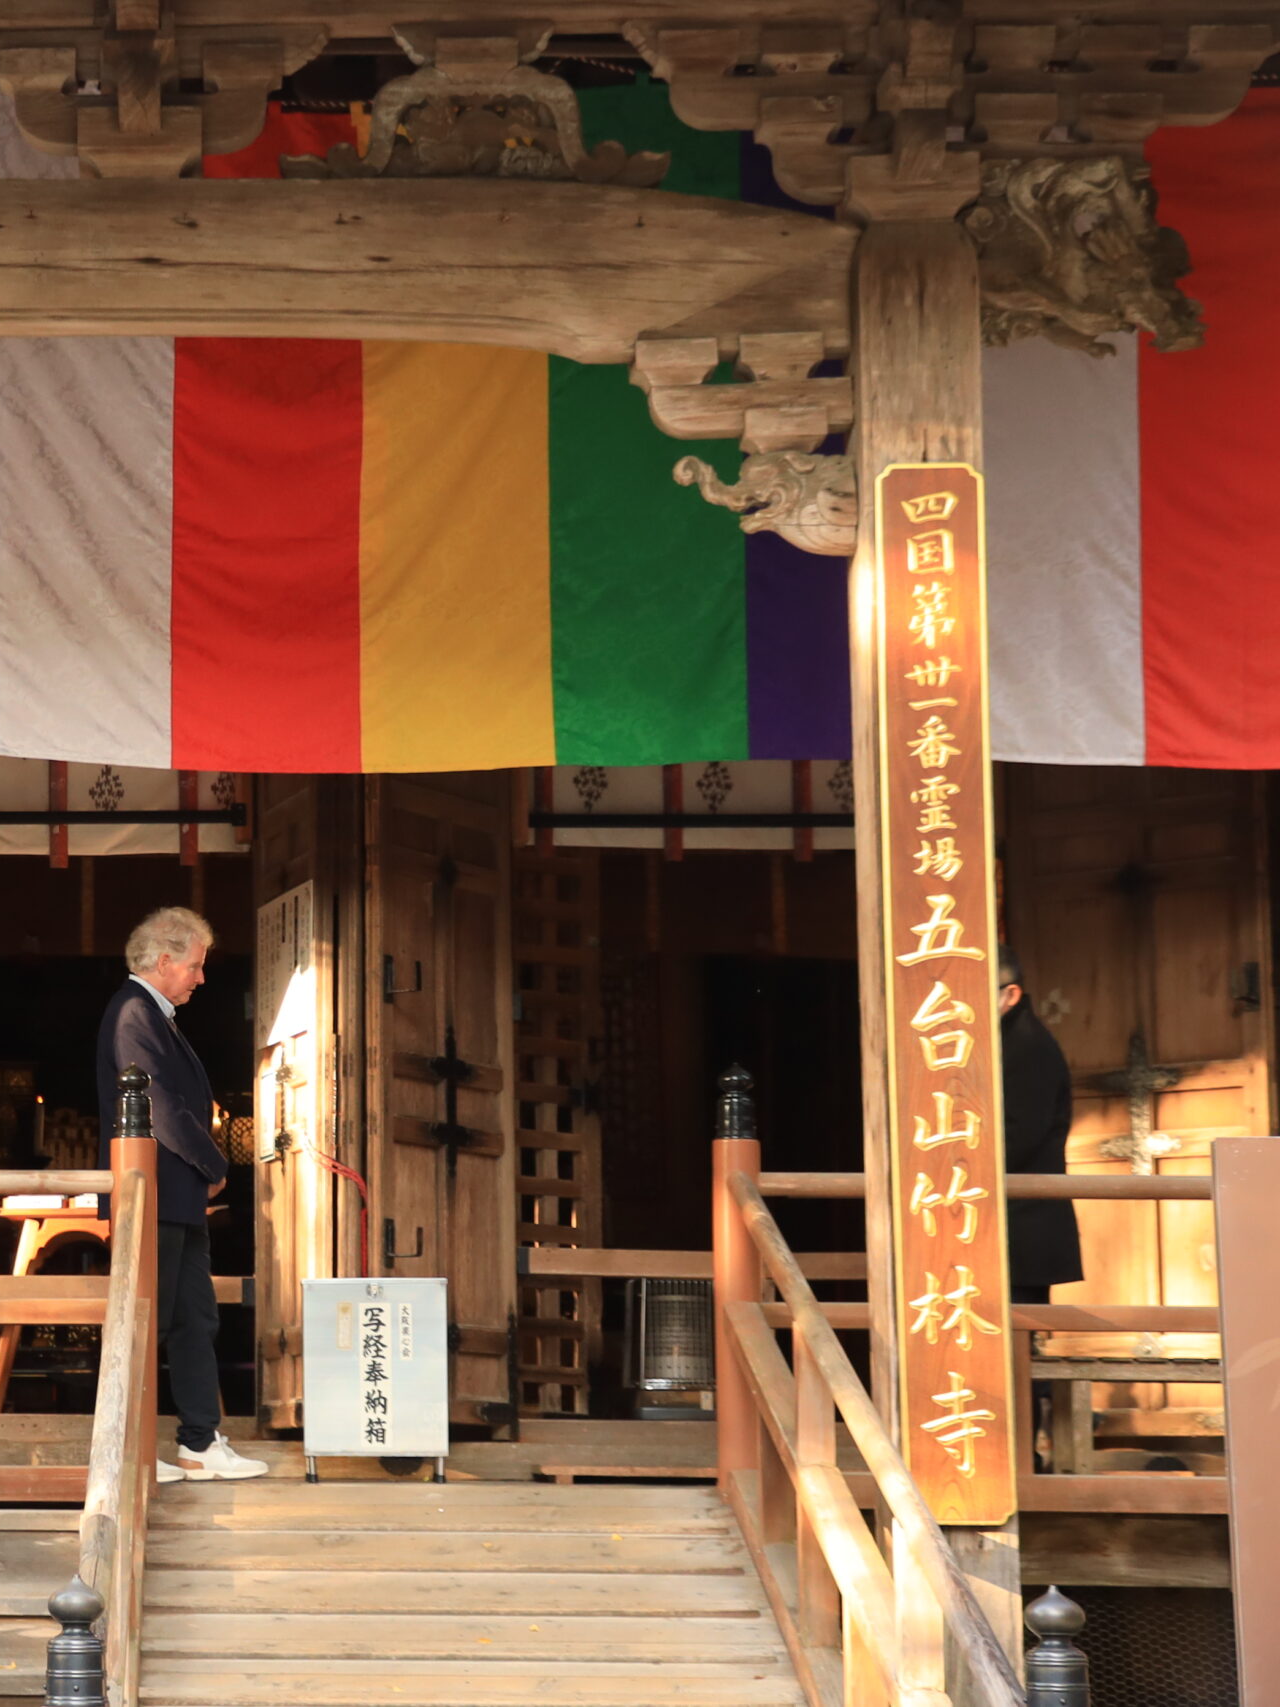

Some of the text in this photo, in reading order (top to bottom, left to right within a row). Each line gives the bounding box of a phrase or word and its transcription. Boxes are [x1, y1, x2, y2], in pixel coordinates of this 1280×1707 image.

[363, 1307, 389, 1444] 写経奉納箱
